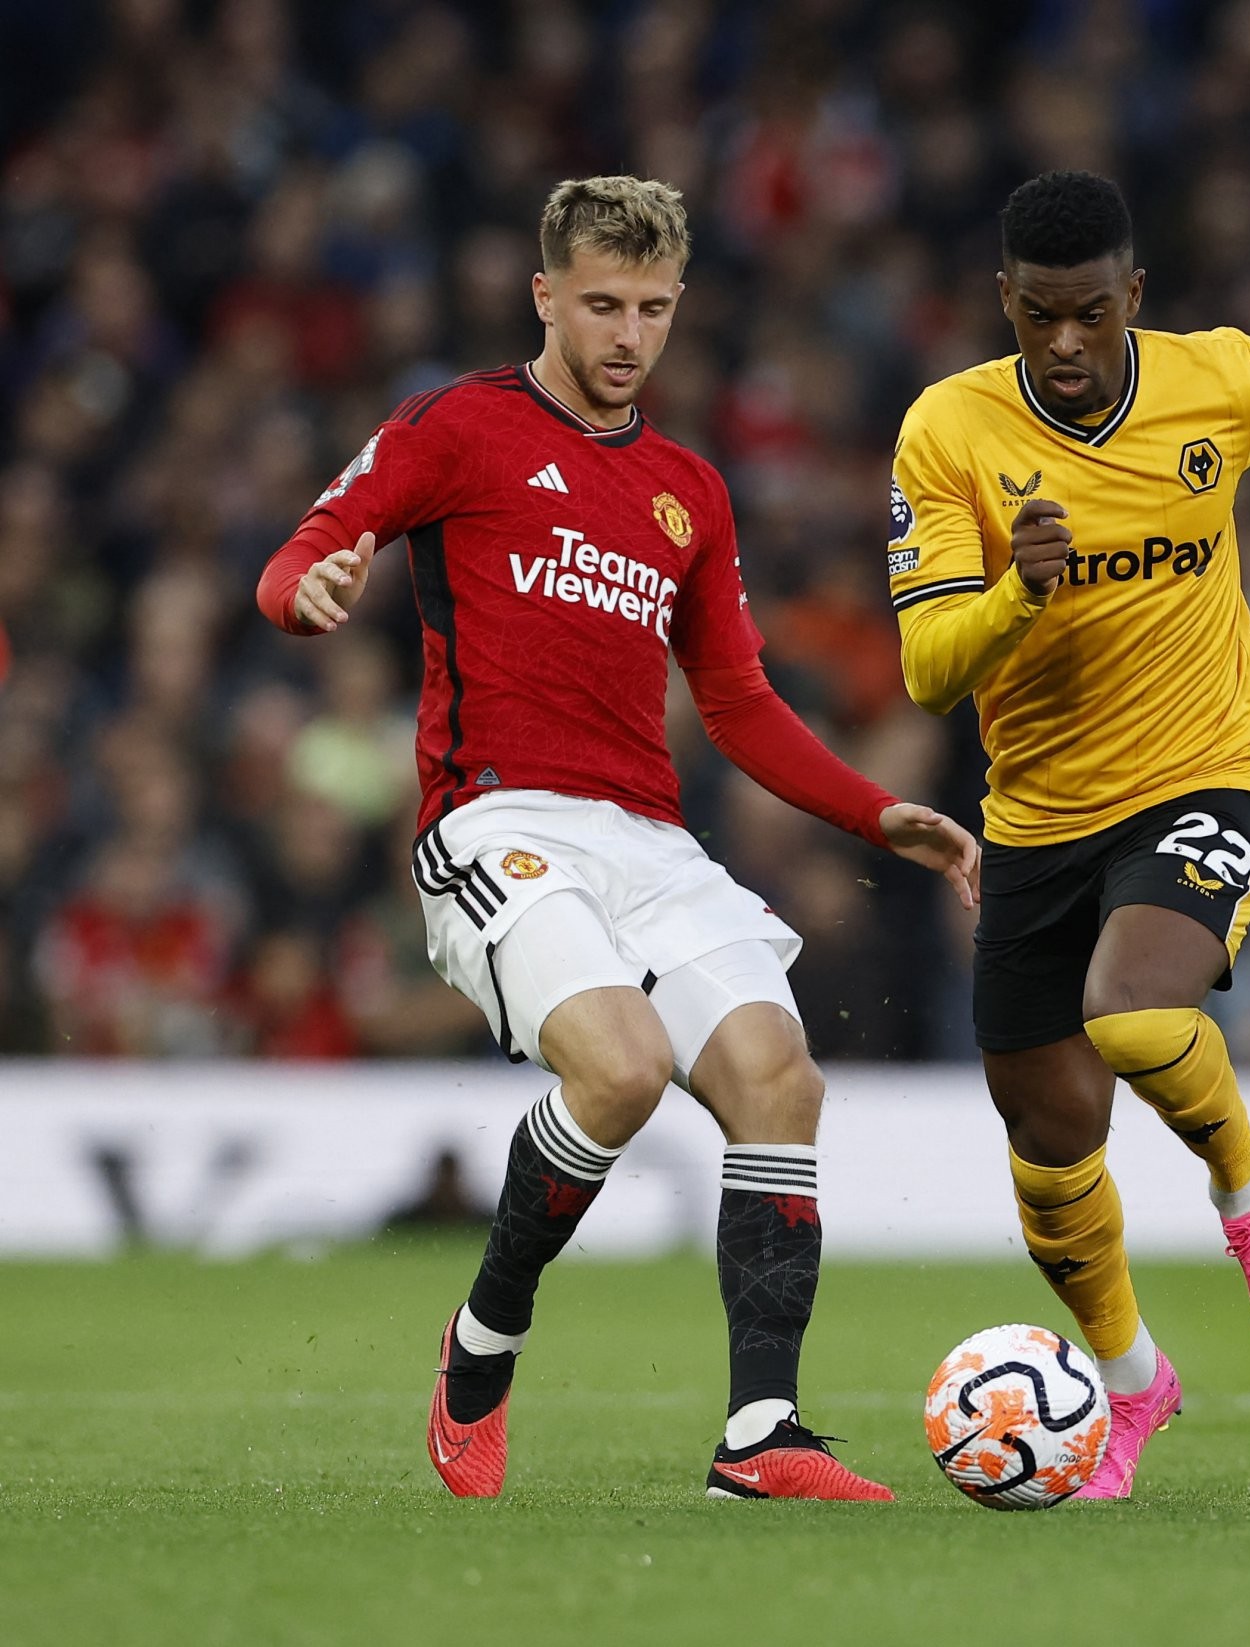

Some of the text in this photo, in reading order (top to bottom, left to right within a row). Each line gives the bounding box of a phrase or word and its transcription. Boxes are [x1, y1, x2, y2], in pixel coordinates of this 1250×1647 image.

[508, 553, 655, 627] Viewer
[551, 525, 660, 599] Team
[1057, 530, 1222, 587] troPay
